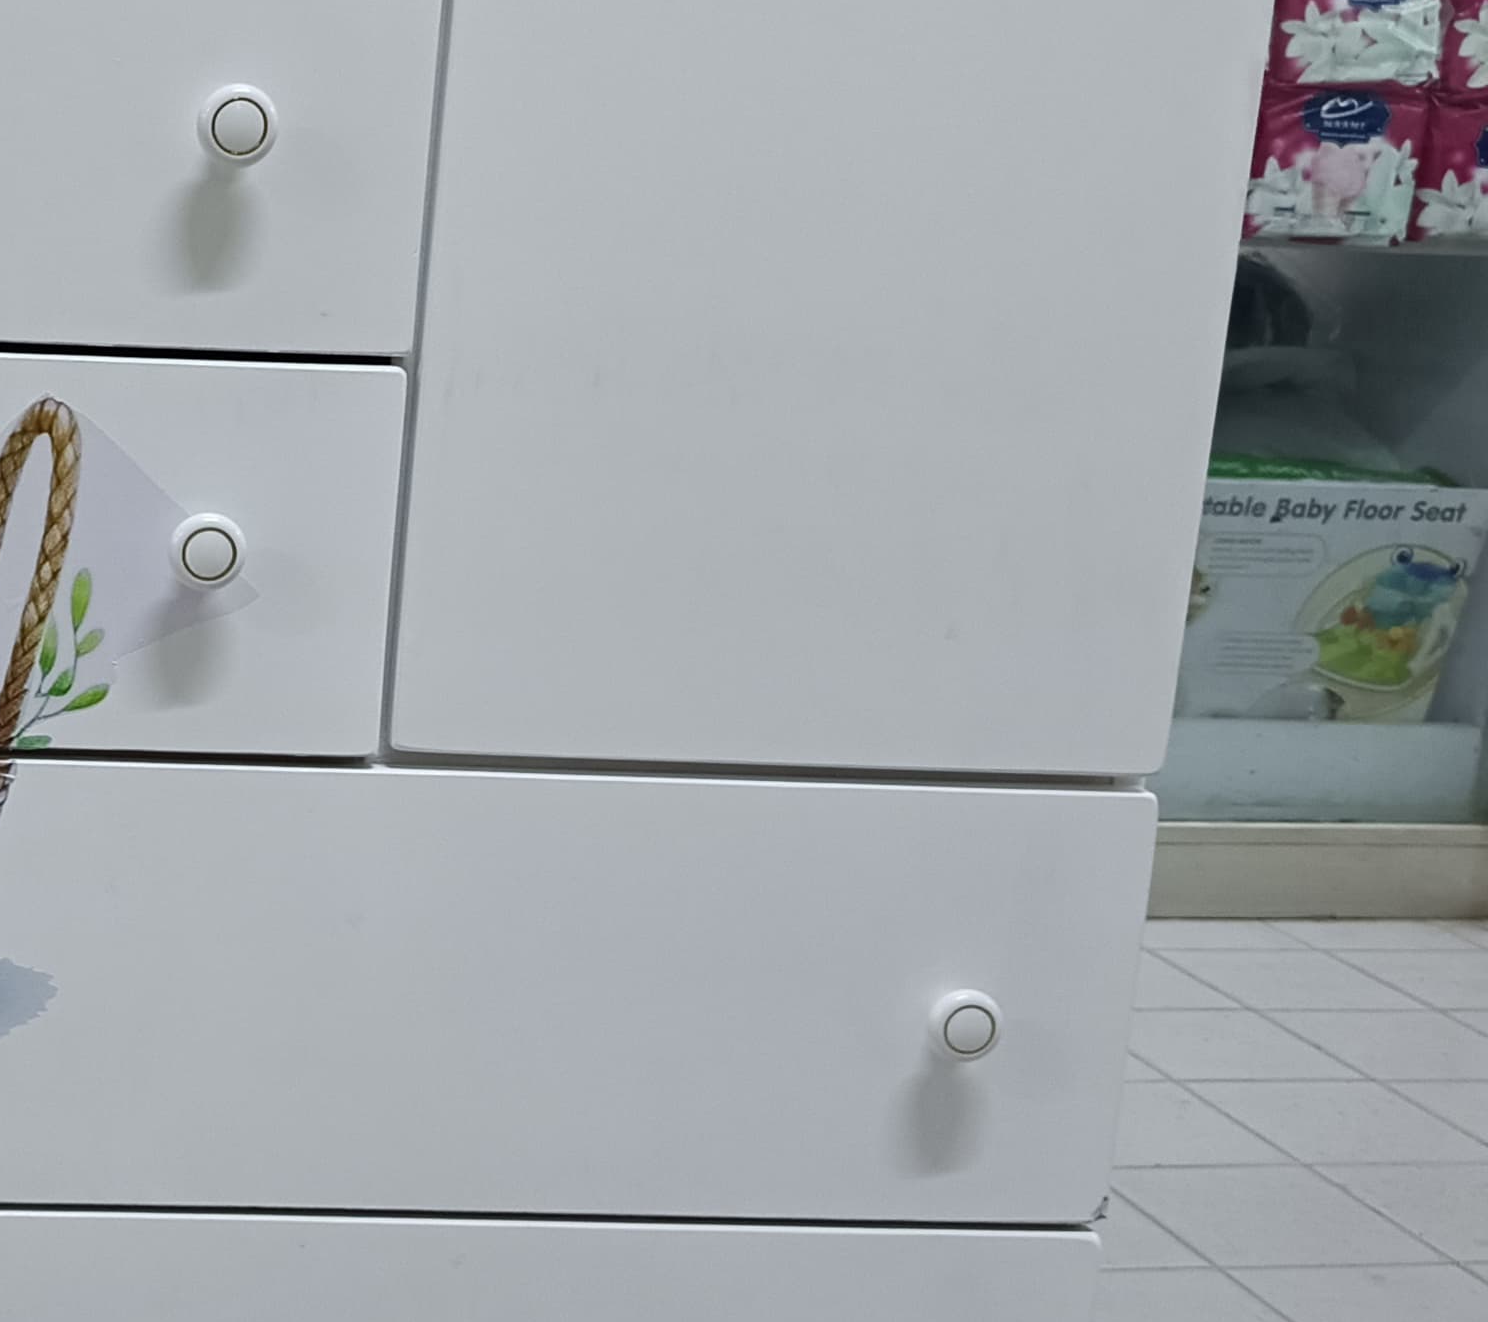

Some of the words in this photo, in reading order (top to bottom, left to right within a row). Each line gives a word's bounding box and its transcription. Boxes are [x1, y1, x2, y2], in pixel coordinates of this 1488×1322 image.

[1277, 497, 1337, 525] Baby
[1343, 499, 1405, 521] Floor
[1410, 500, 1467, 524] Seat
